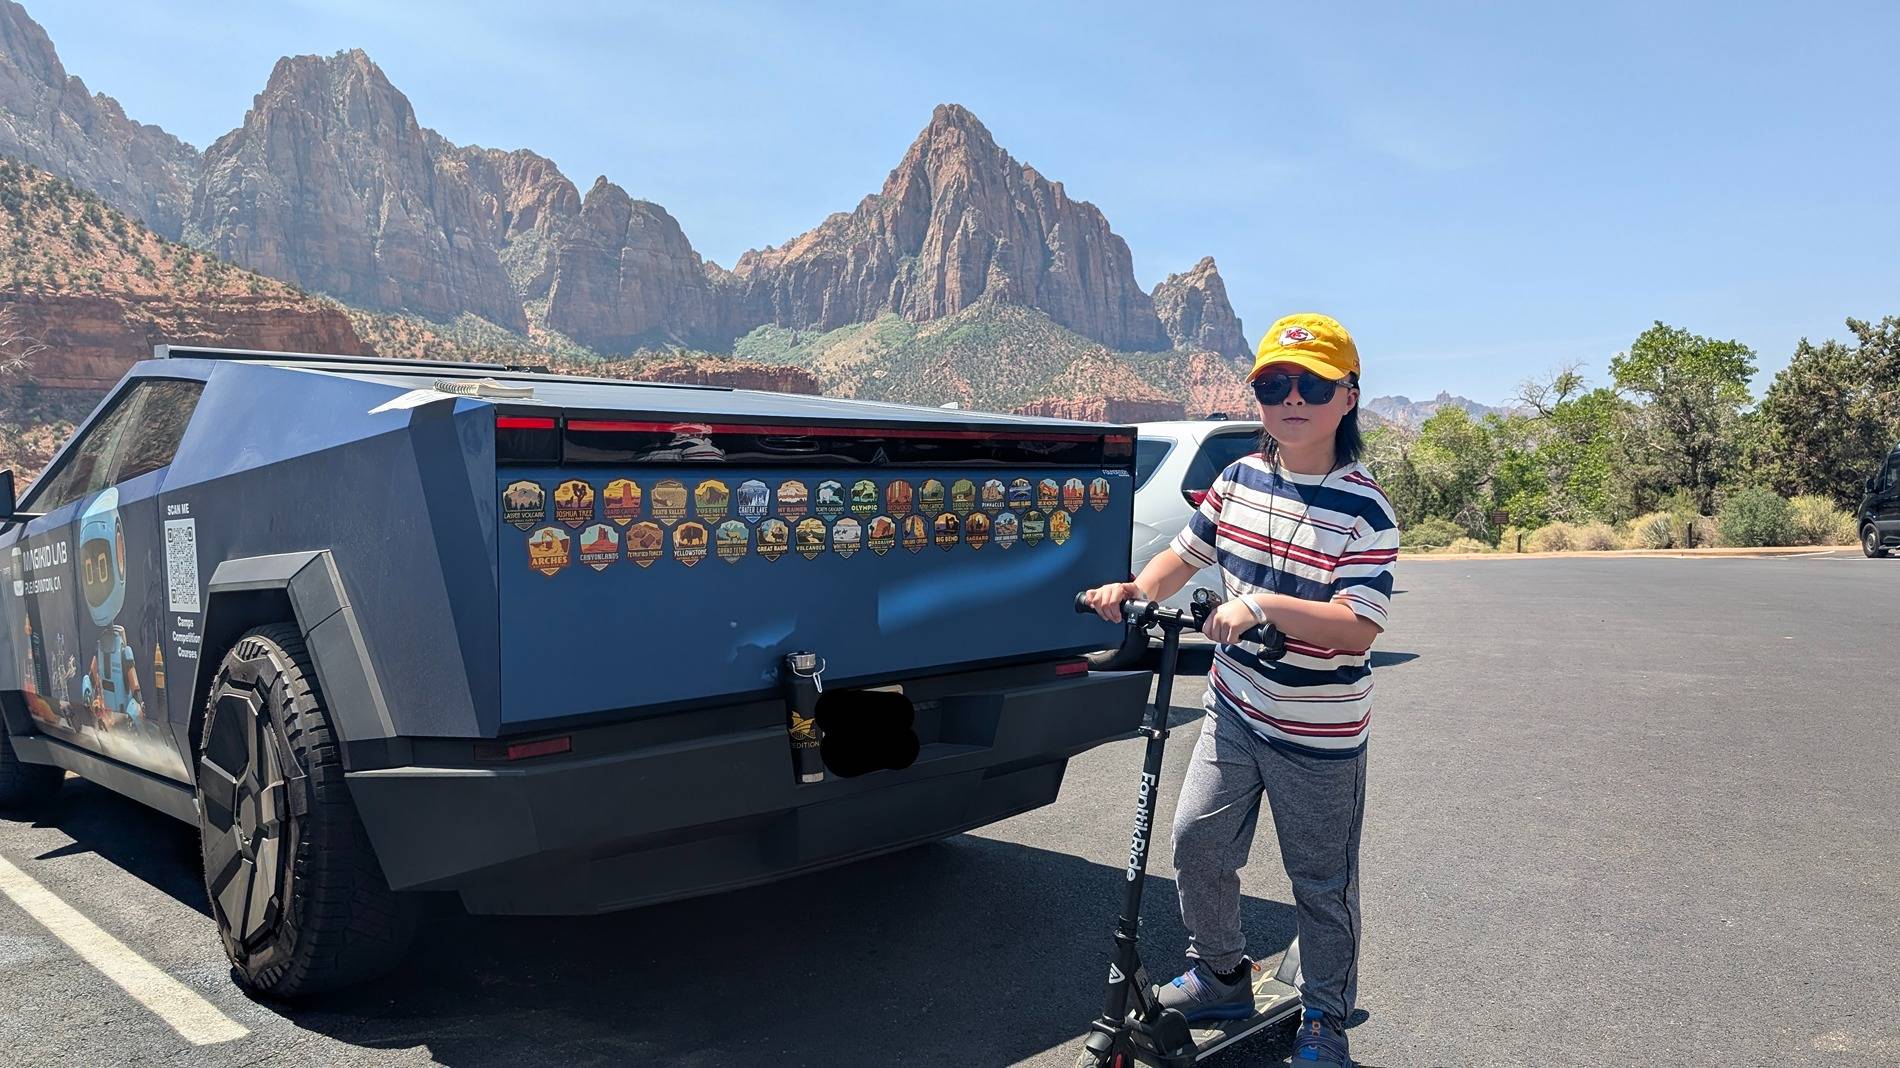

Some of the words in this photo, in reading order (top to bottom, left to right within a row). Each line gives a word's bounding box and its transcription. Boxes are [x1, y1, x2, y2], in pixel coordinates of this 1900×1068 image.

[167, 504, 181, 515] SCAN
[181, 503, 190, 514] ME
[556, 510, 577, 518] JOSHUA
[52, 541, 68, 565] LAB
[580, 553, 619, 561] CANYONLANDS
[674, 549, 707, 557] YELLOWSTONE
[531, 555, 568, 566] ARCHES
[178, 616, 194, 629] Camps
[172, 630, 200, 644] Competition
[178, 647, 197, 659] Courses
